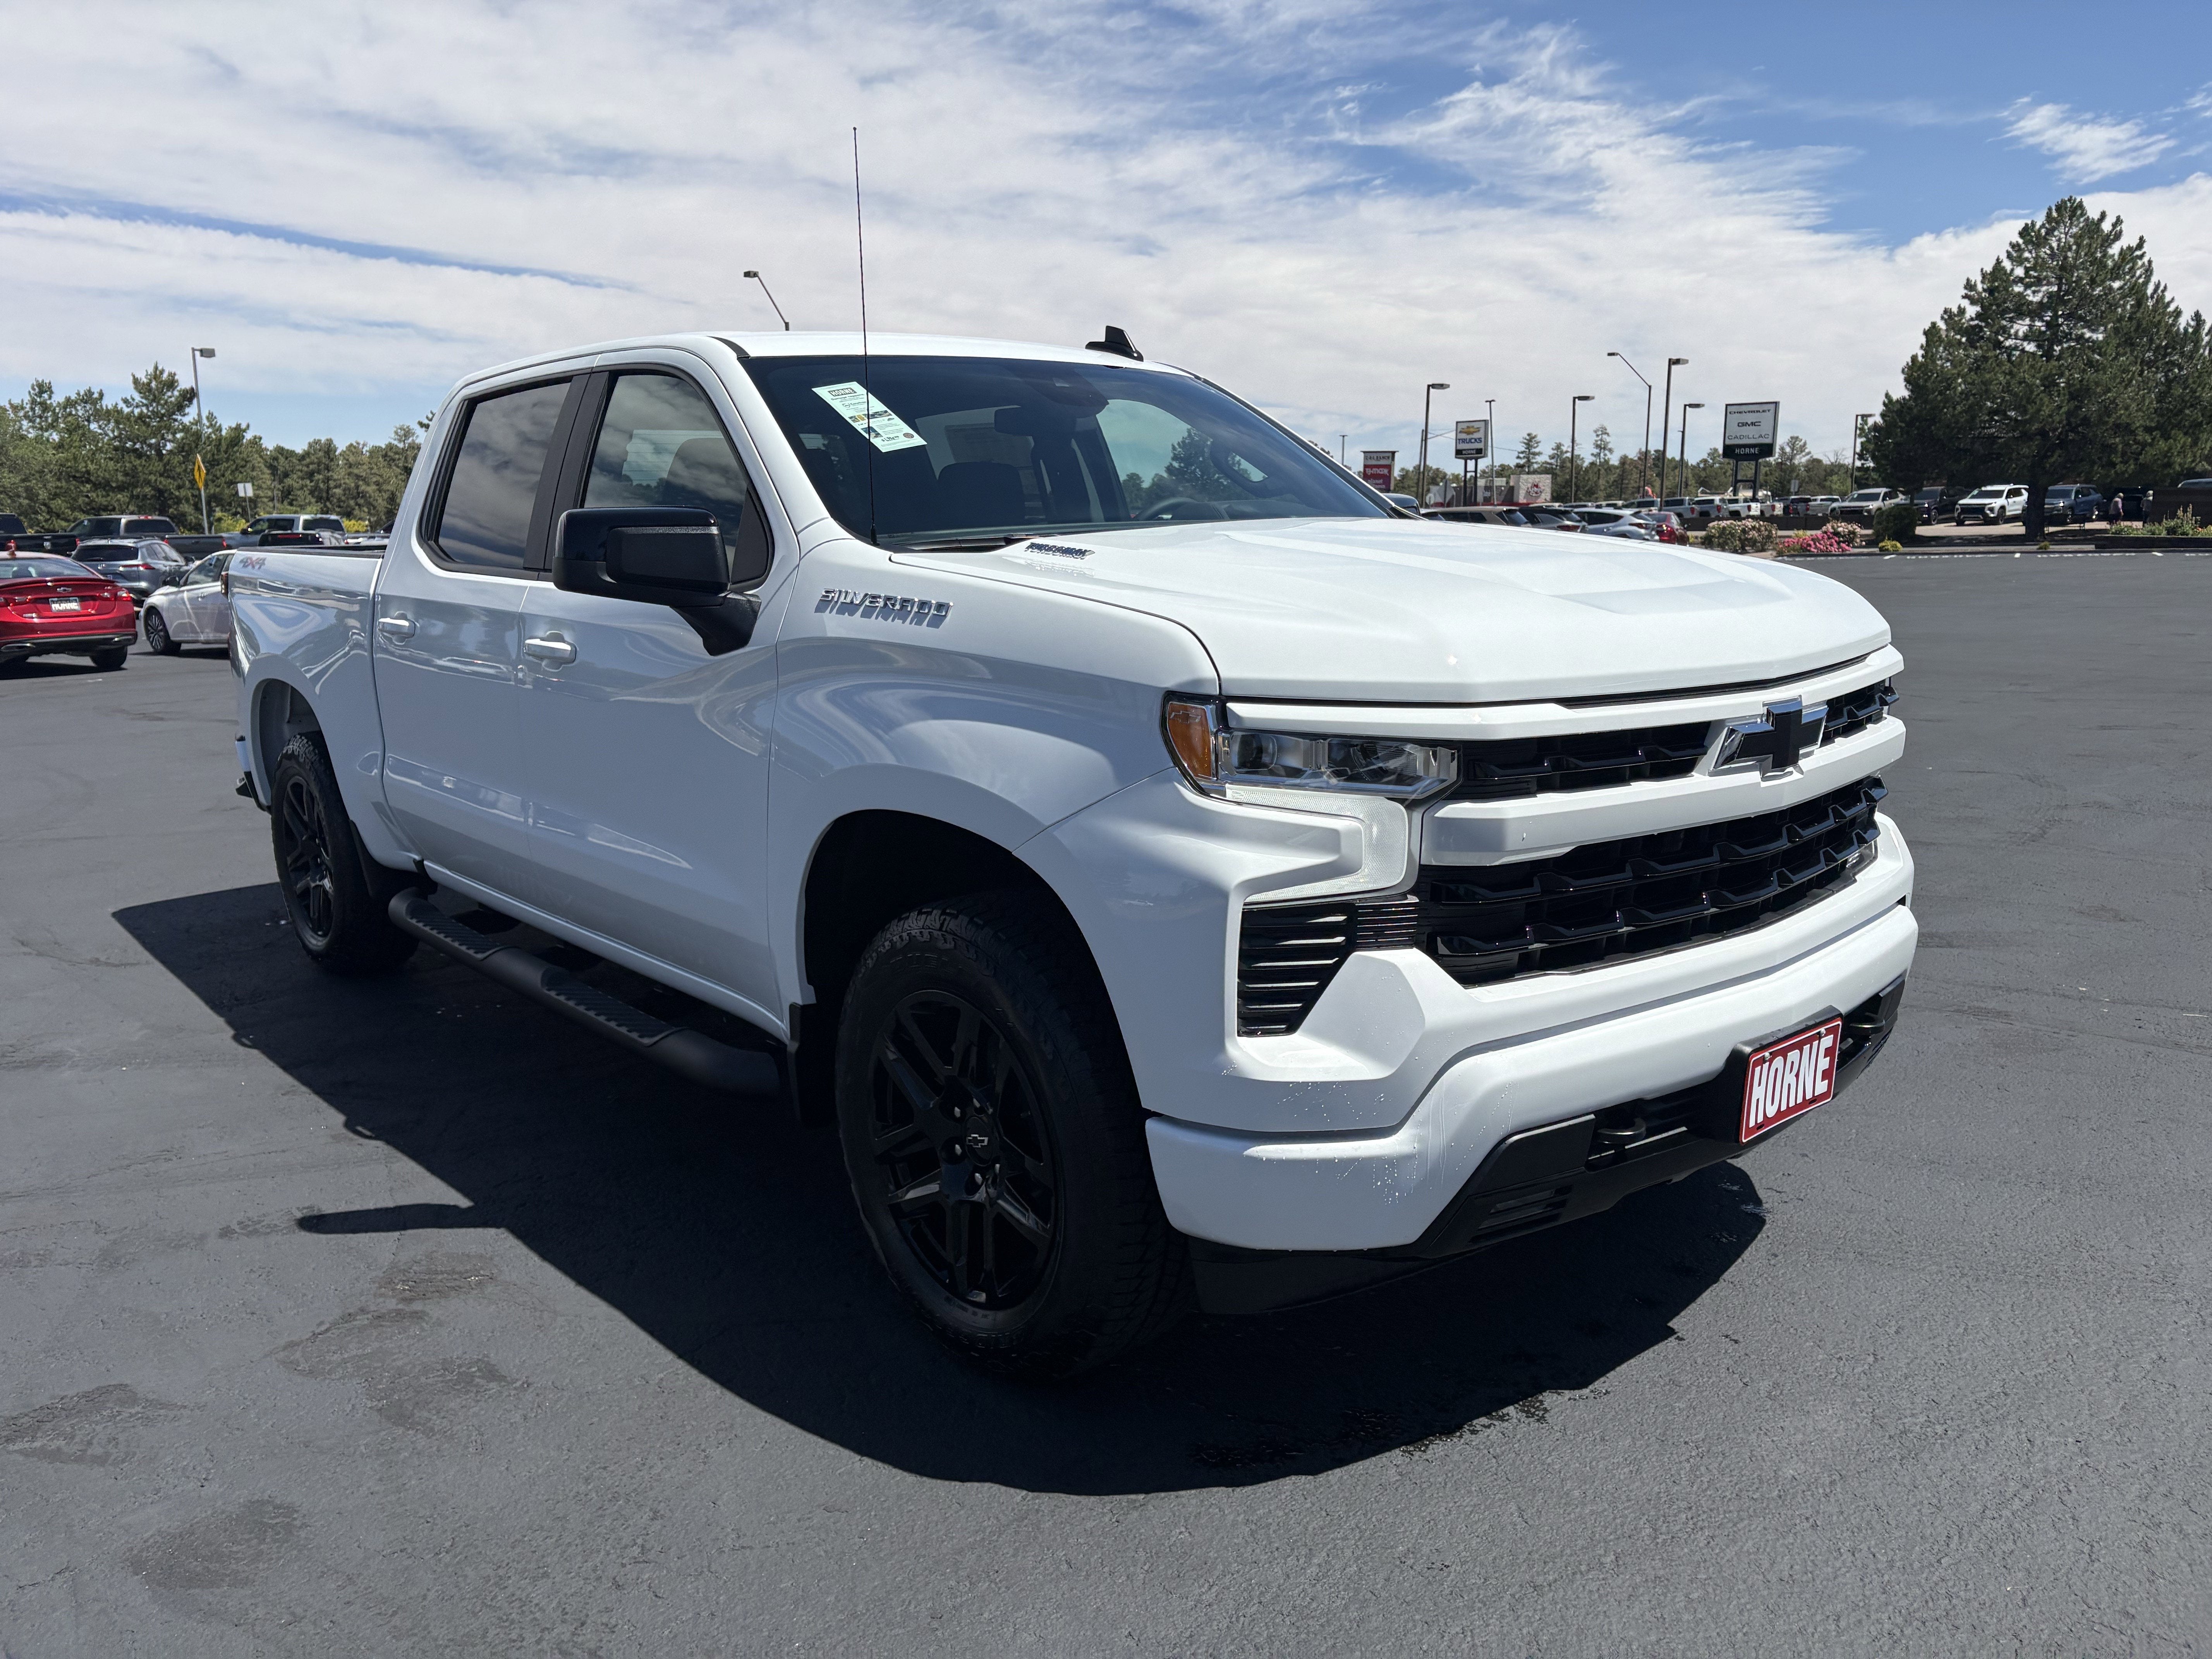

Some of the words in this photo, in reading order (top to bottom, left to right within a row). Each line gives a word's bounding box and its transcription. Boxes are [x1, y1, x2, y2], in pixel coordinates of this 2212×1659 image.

[830, 388, 855, 396] HORNE
[819, 588, 954, 617] SILVERADO
[1749, 1034, 1834, 1128] HORNE
